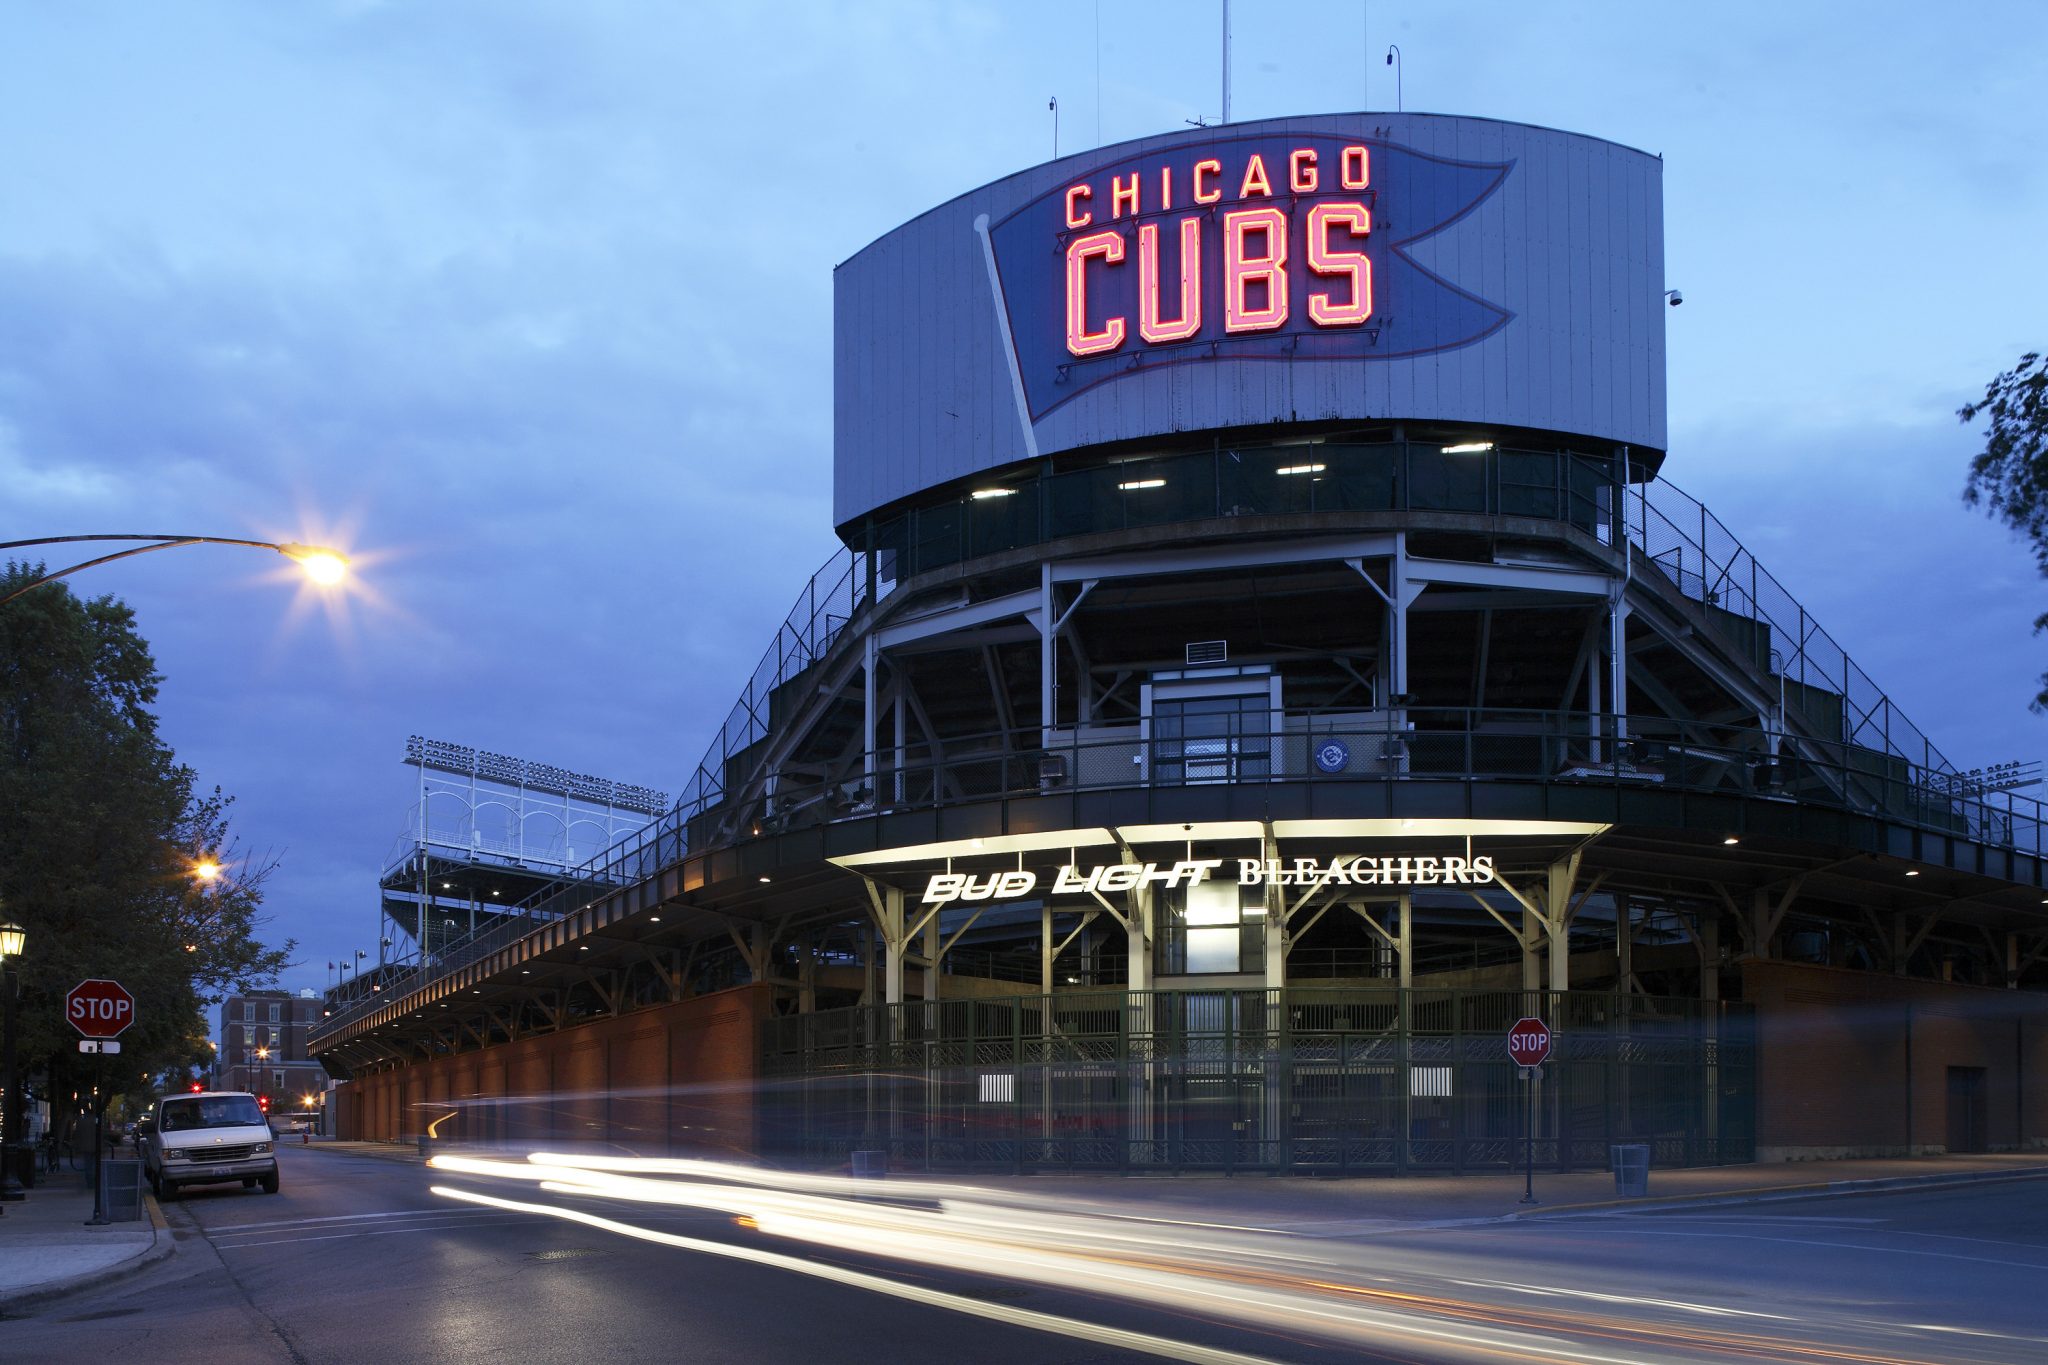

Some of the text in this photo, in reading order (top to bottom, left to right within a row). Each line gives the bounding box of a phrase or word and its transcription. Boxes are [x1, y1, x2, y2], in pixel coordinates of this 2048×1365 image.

[1066, 146, 1370, 229] CHICAGO
[1066, 202, 1372, 356] CUBS
[1239, 856, 1494, 885] BLEACHERS
[72, 997, 130, 1020] STOP
[1511, 1033, 1547, 1052] STOP
